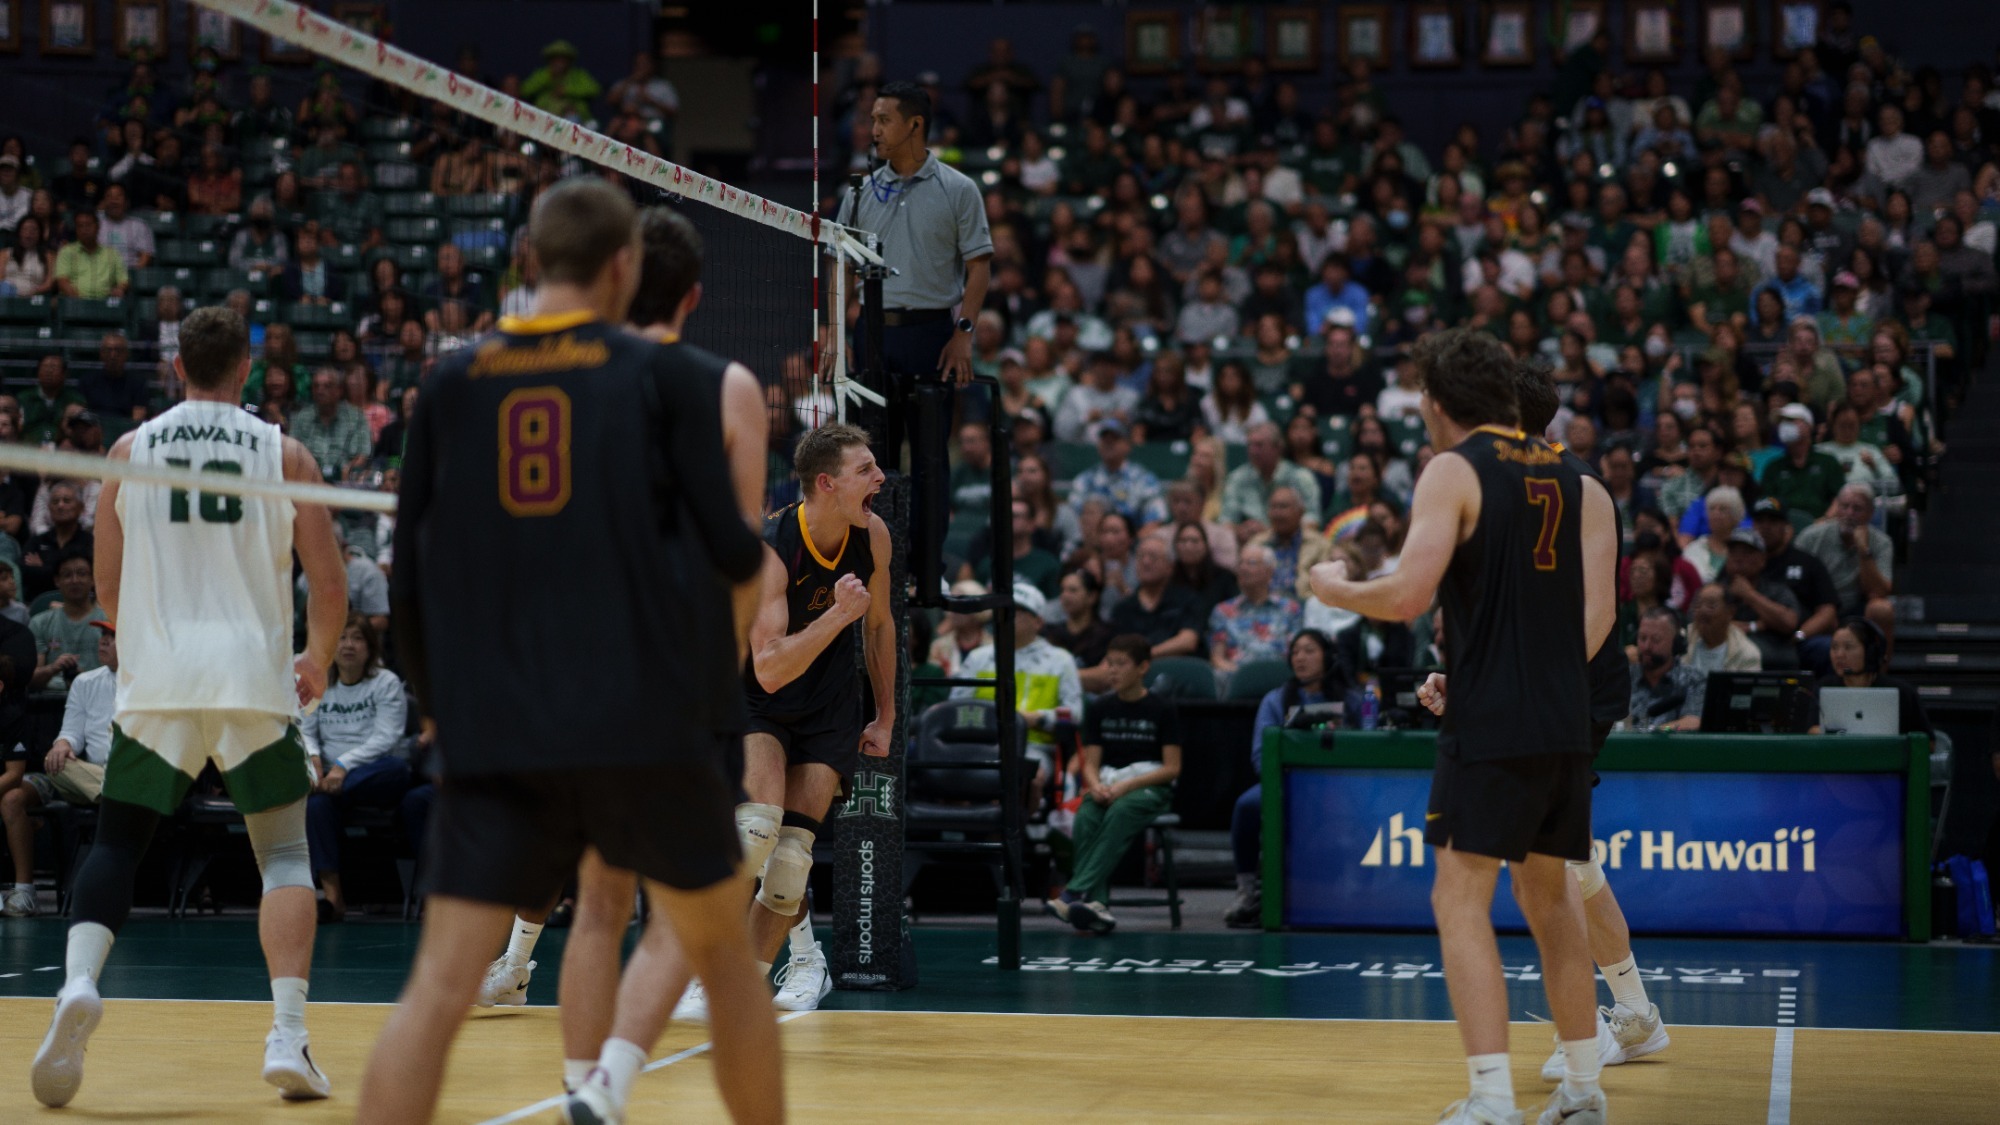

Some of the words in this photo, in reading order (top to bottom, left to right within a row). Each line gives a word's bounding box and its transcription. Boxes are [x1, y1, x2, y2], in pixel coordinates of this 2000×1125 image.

[498, 386, 571, 517] 8
[1524, 477, 1564, 570] 7
[858, 840, 874, 894] sports
[856, 898, 873, 964] imports
